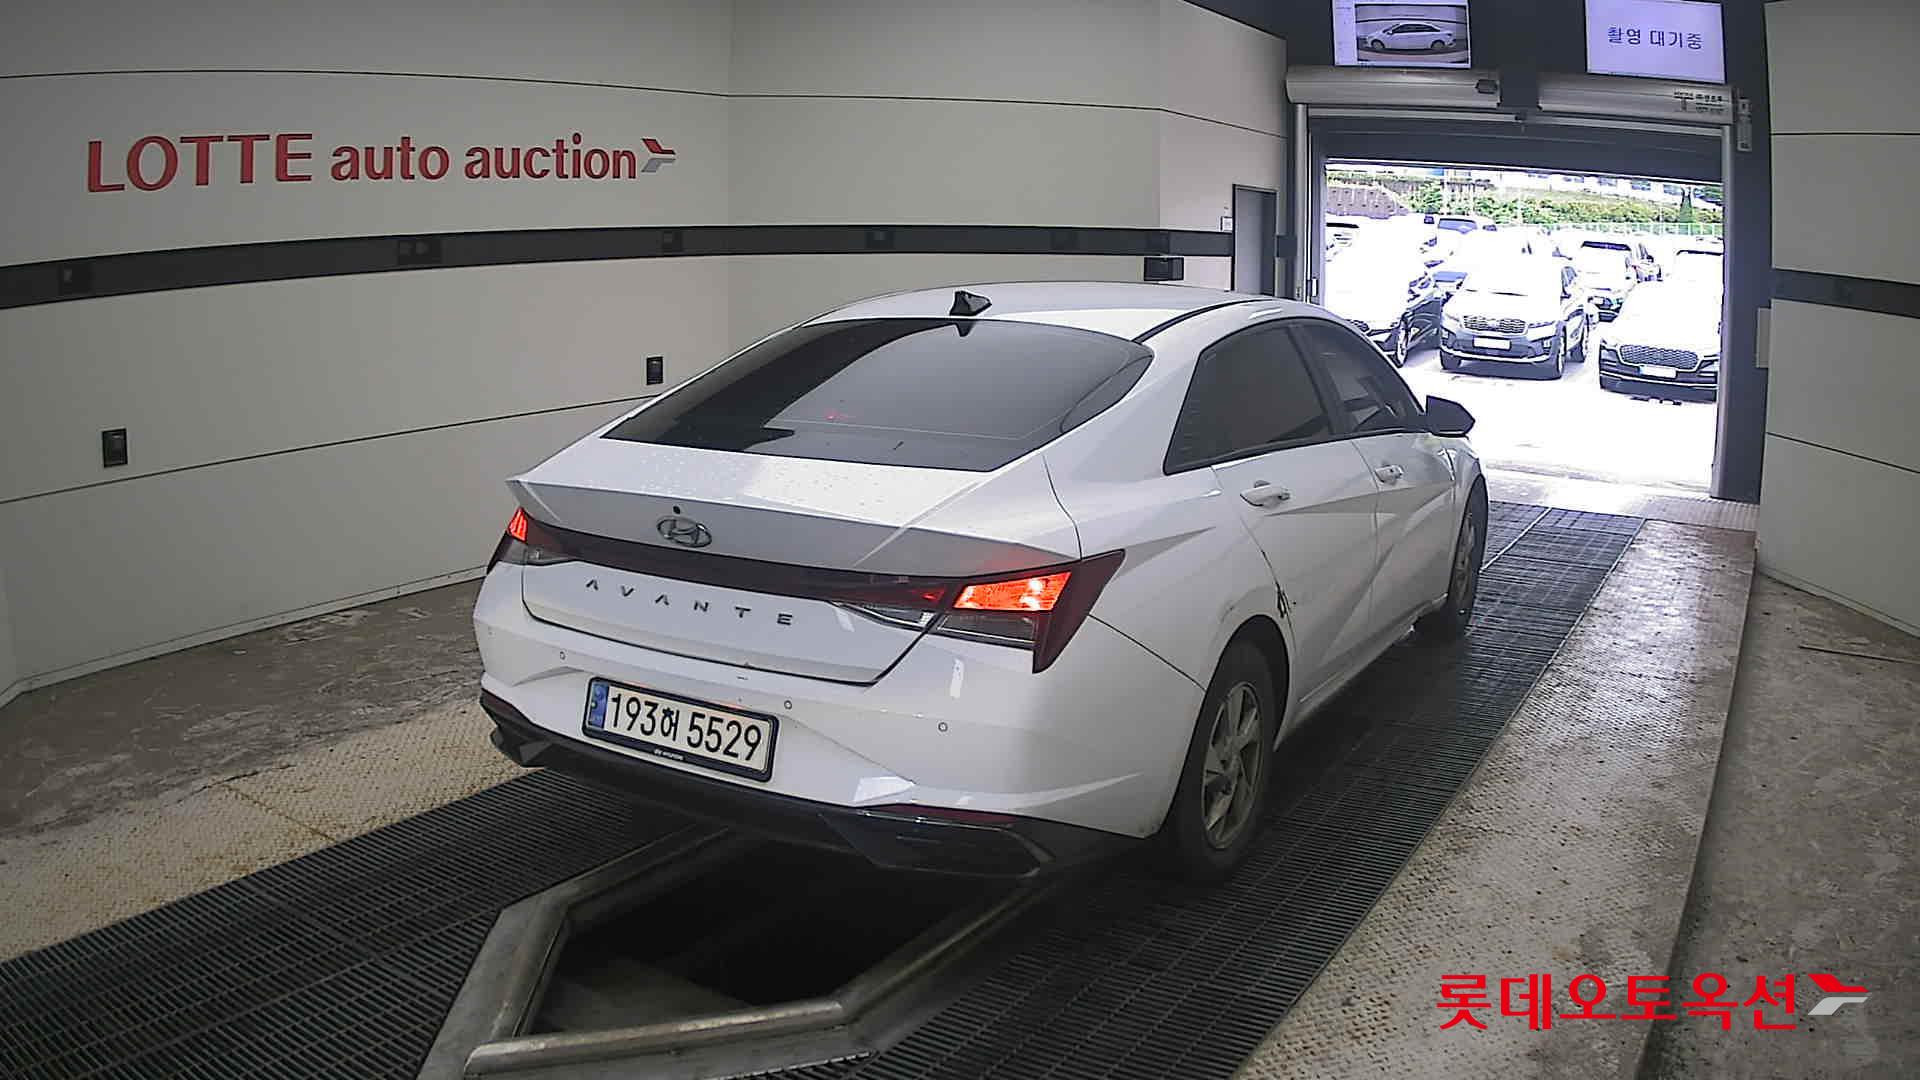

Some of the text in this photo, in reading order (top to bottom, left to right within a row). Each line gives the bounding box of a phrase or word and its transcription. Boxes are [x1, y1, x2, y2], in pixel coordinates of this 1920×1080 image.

[1607, 27, 1703, 50] 촬영 대기중
[87, 133, 637, 192] LOTTE auto auction
[585, 579, 793, 626] AVANTE
[686, 711, 762, 761] 5529
